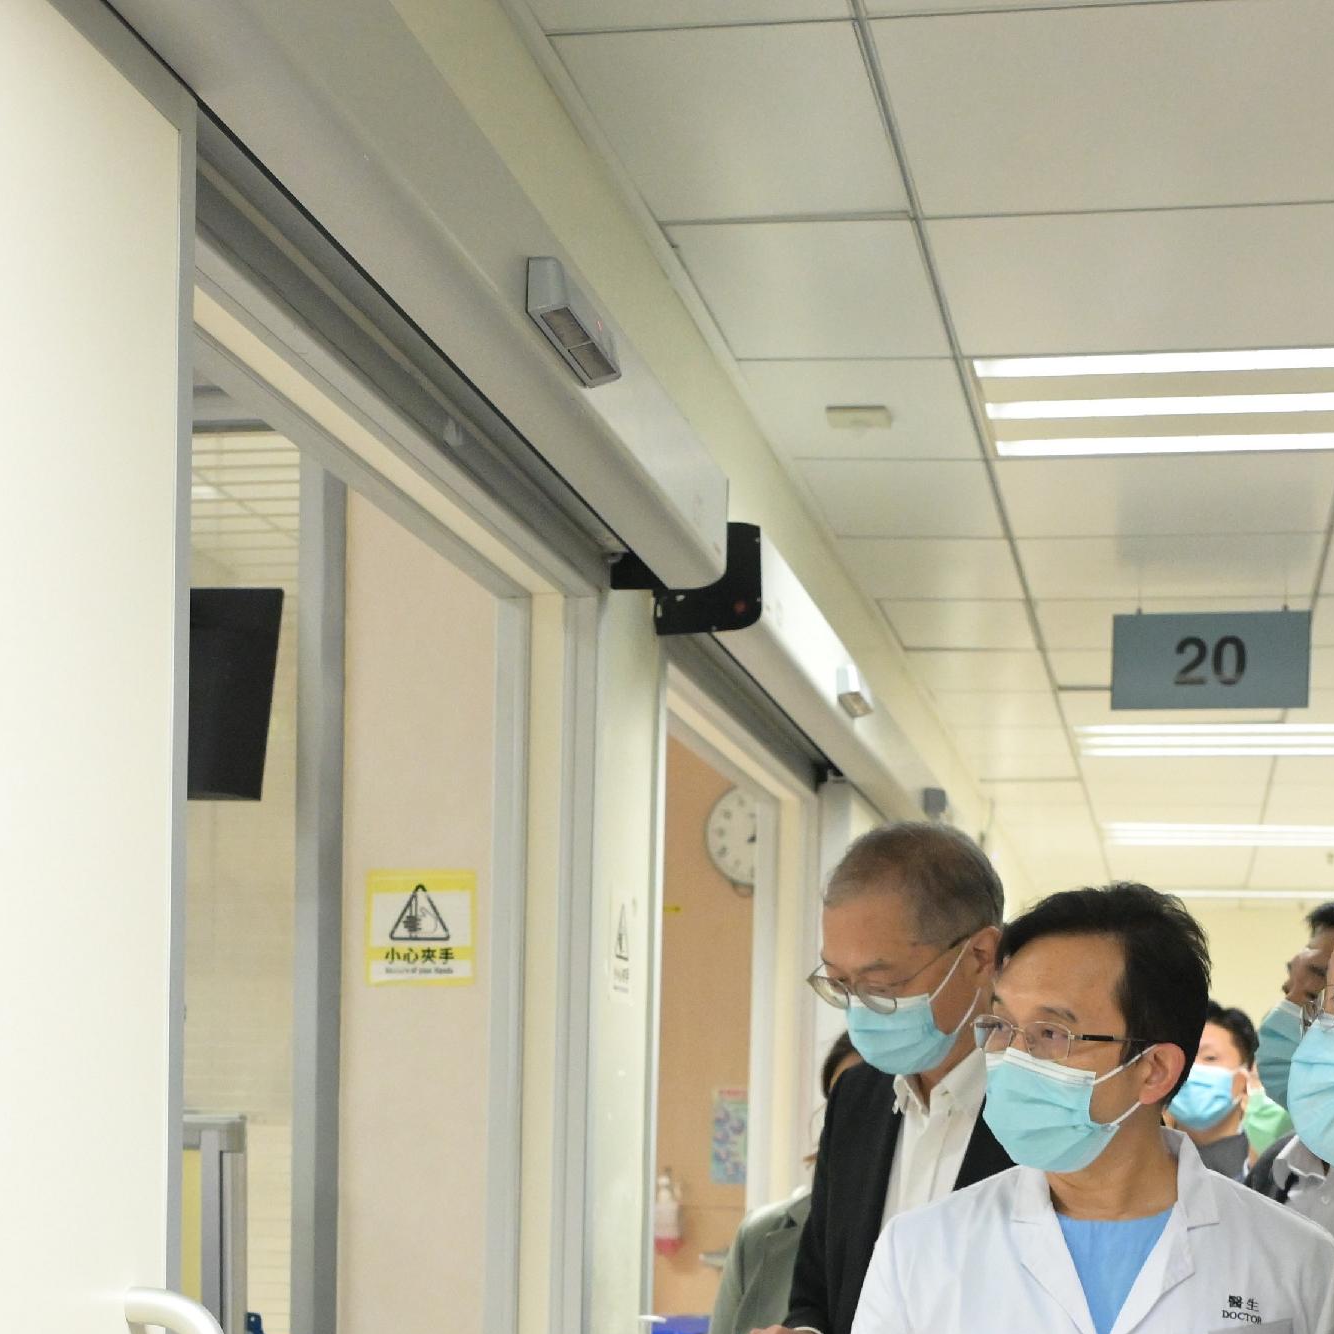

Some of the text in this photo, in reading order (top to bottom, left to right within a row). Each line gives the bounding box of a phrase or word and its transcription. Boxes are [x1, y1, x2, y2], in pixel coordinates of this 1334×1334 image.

[1174, 635, 1247, 686] 20
[385, 947, 454, 964] 小心夾手
[1228, 1295, 1260, 1312] 醫生
[1222, 1310, 1262, 1325] DOCTOR
